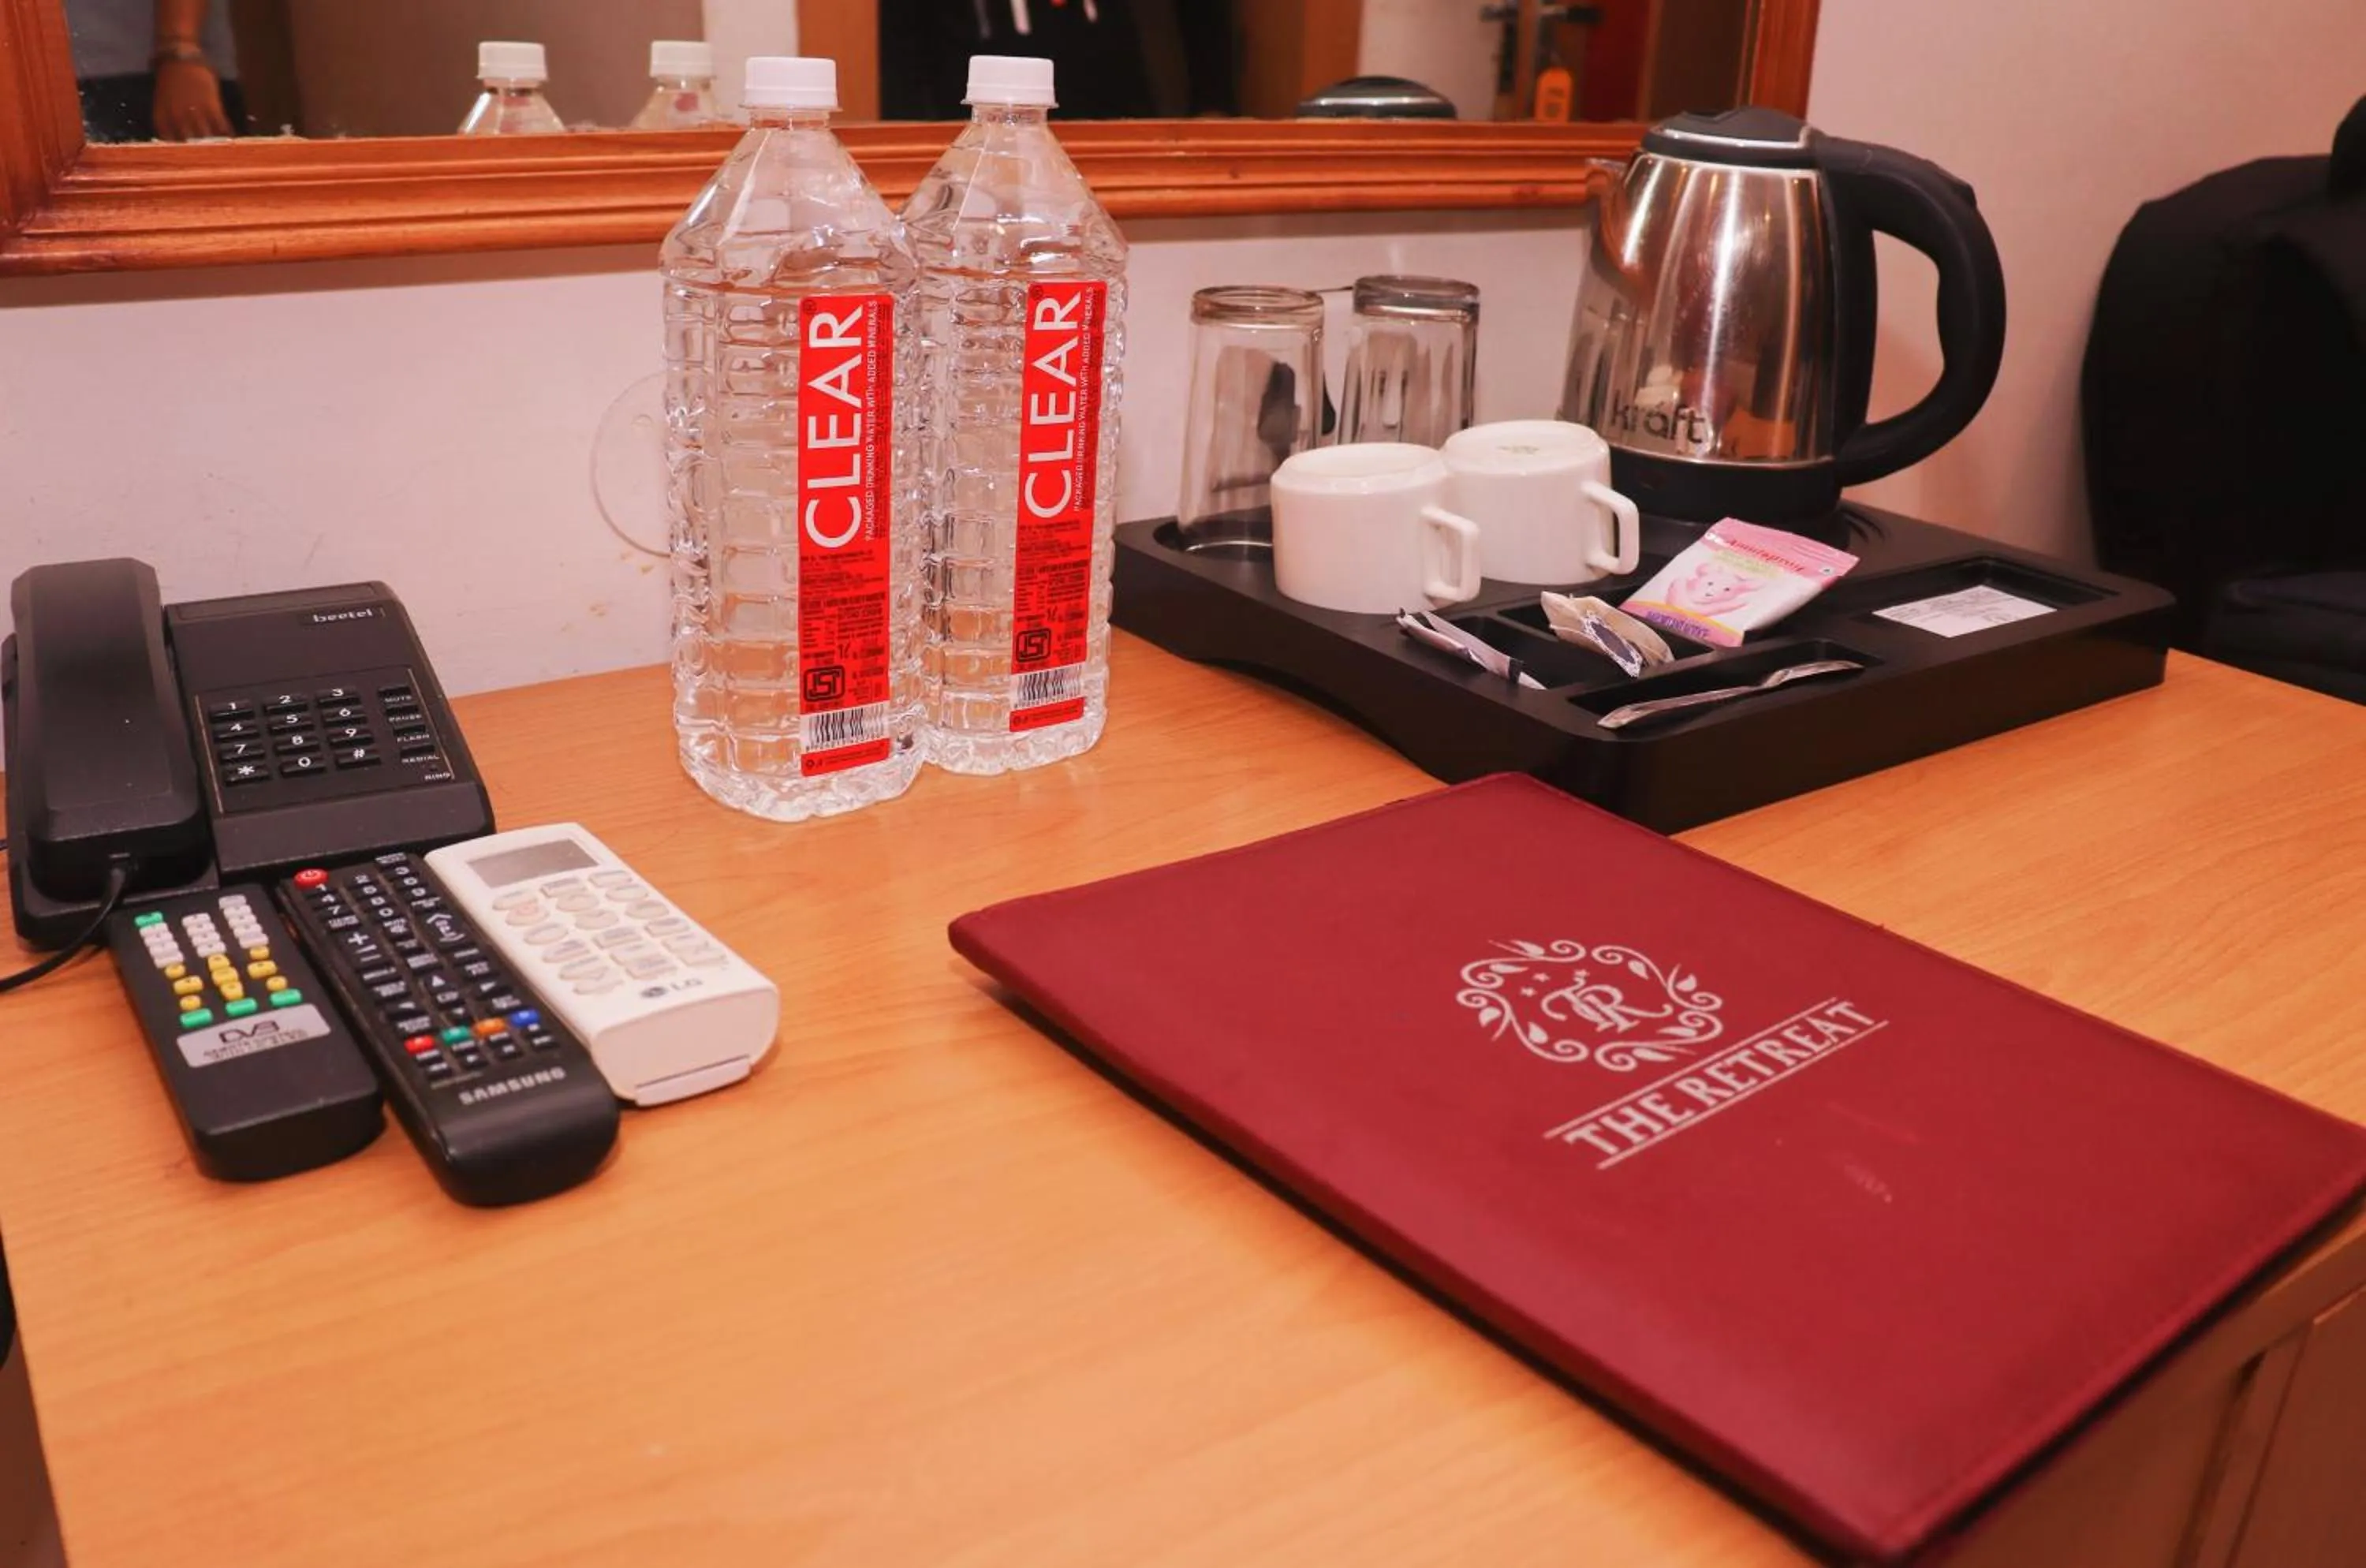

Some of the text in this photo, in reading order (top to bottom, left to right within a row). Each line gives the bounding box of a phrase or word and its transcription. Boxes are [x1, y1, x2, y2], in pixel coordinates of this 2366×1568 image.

[1024, 291, 1081, 518] CLEAR
[1074, 287, 1094, 511] PACKAGED DRINKING WATER WITH ADDED MINERALS
[1612, 390, 1705, 443] kraft
[804, 305, 863, 548] CLEAR
[865, 301, 878, 541] PACKAGED DRINKING WATER WITH ADDED MINERALS
[313, 608, 373, 623] beetel
[228, 688, 344, 710] 1 2 3
[286, 714, 298, 723] 5
[339, 708, 351, 717] 6
[235, 727, 357, 754] 7 8 9
[297, 756, 312, 767] 0
[353, 749, 365, 759] #
[328, 905, 341, 915] 7
[459, 1066, 565, 1104] SAMSUNG
[1562, 1001, 1876, 1158] THE RETREAT
